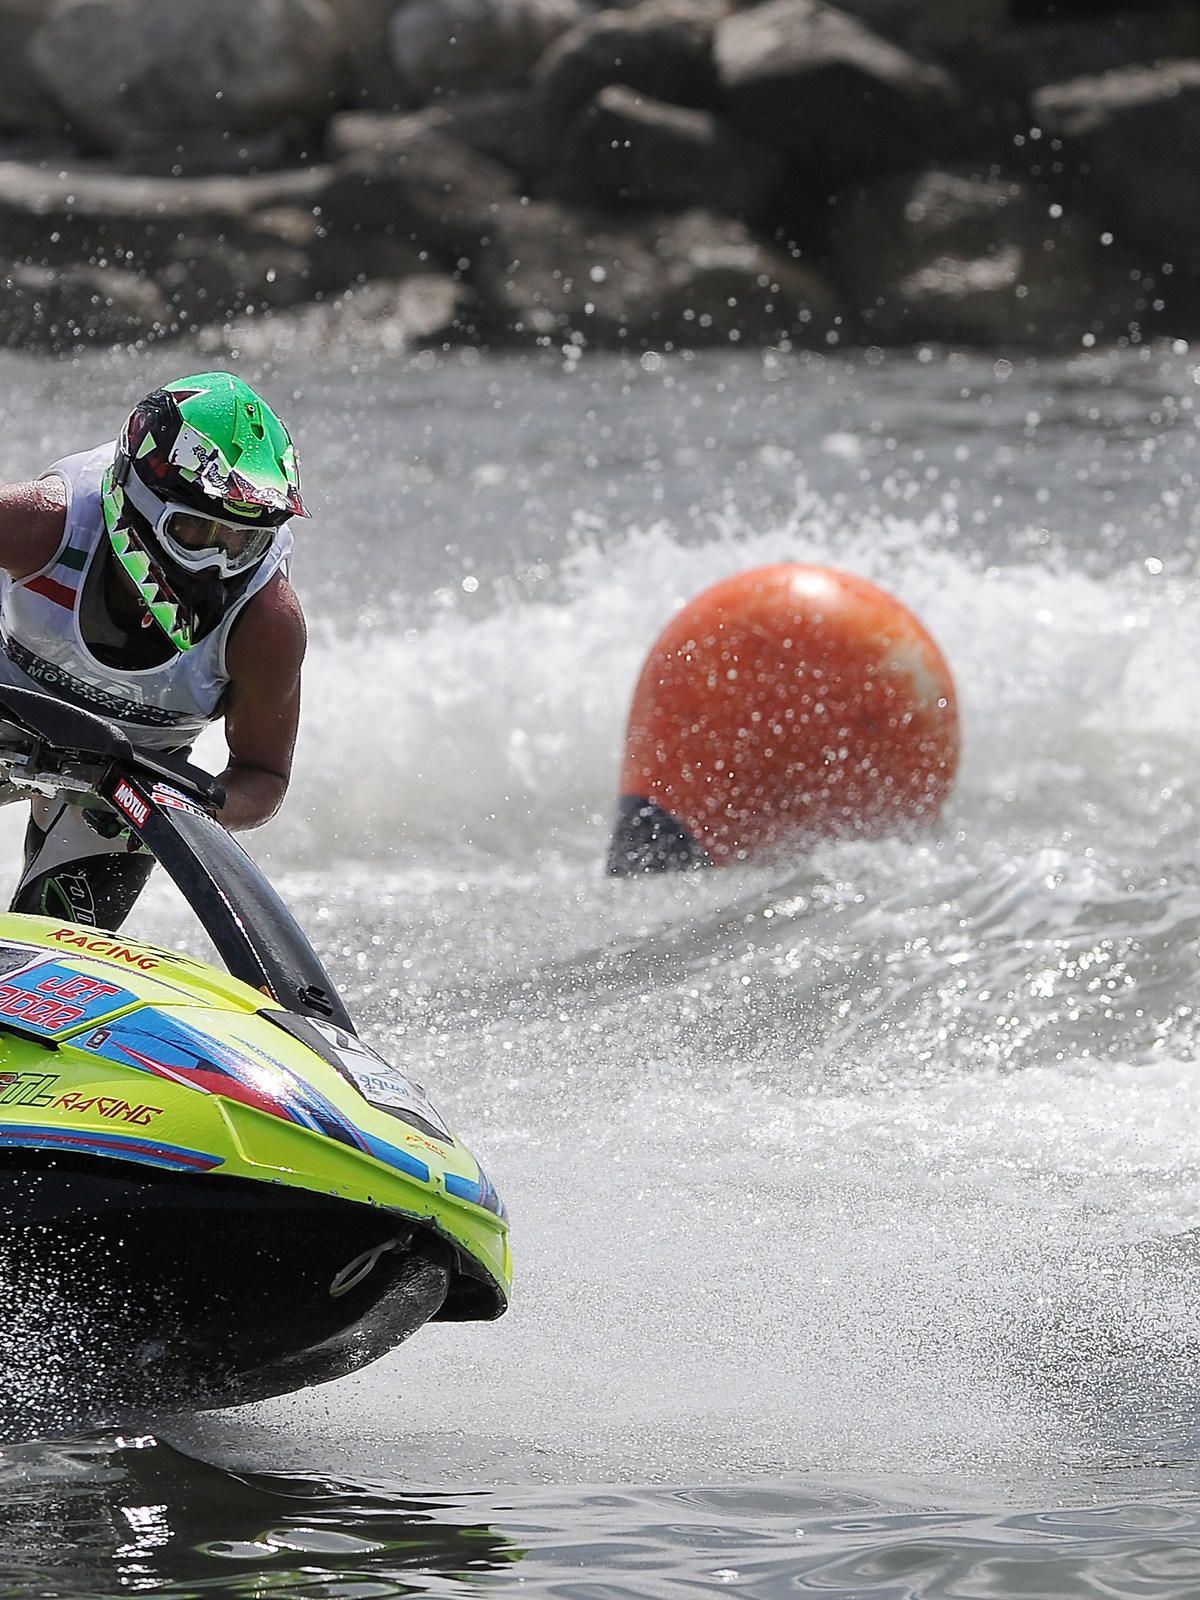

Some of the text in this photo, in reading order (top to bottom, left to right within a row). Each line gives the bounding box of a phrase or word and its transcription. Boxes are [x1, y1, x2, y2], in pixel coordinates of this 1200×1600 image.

[114, 783, 149, 824] MOTUL
[46, 928, 160, 970] RACING
[51, 1092, 164, 1126] RACING
